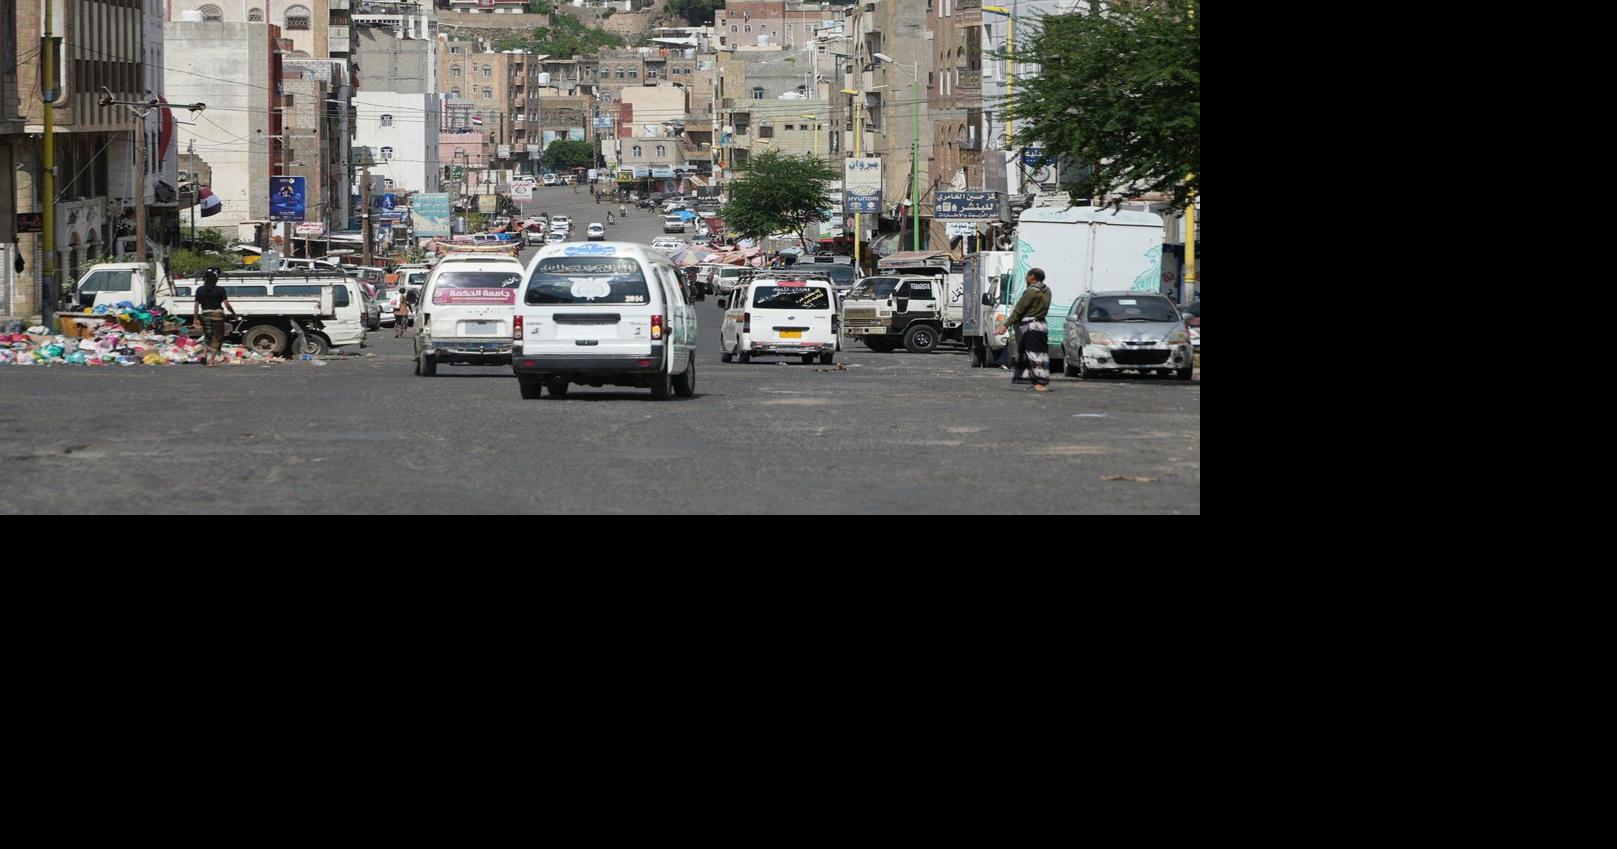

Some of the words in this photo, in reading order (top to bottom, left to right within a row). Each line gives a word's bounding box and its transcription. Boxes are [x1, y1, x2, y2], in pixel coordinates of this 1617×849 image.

[967, 193, 985, 201] حسين
[959, 202, 994, 213] للبنشر
[449, 289, 482, 297] الحكمة
[482, 289, 511, 297] جامعة
